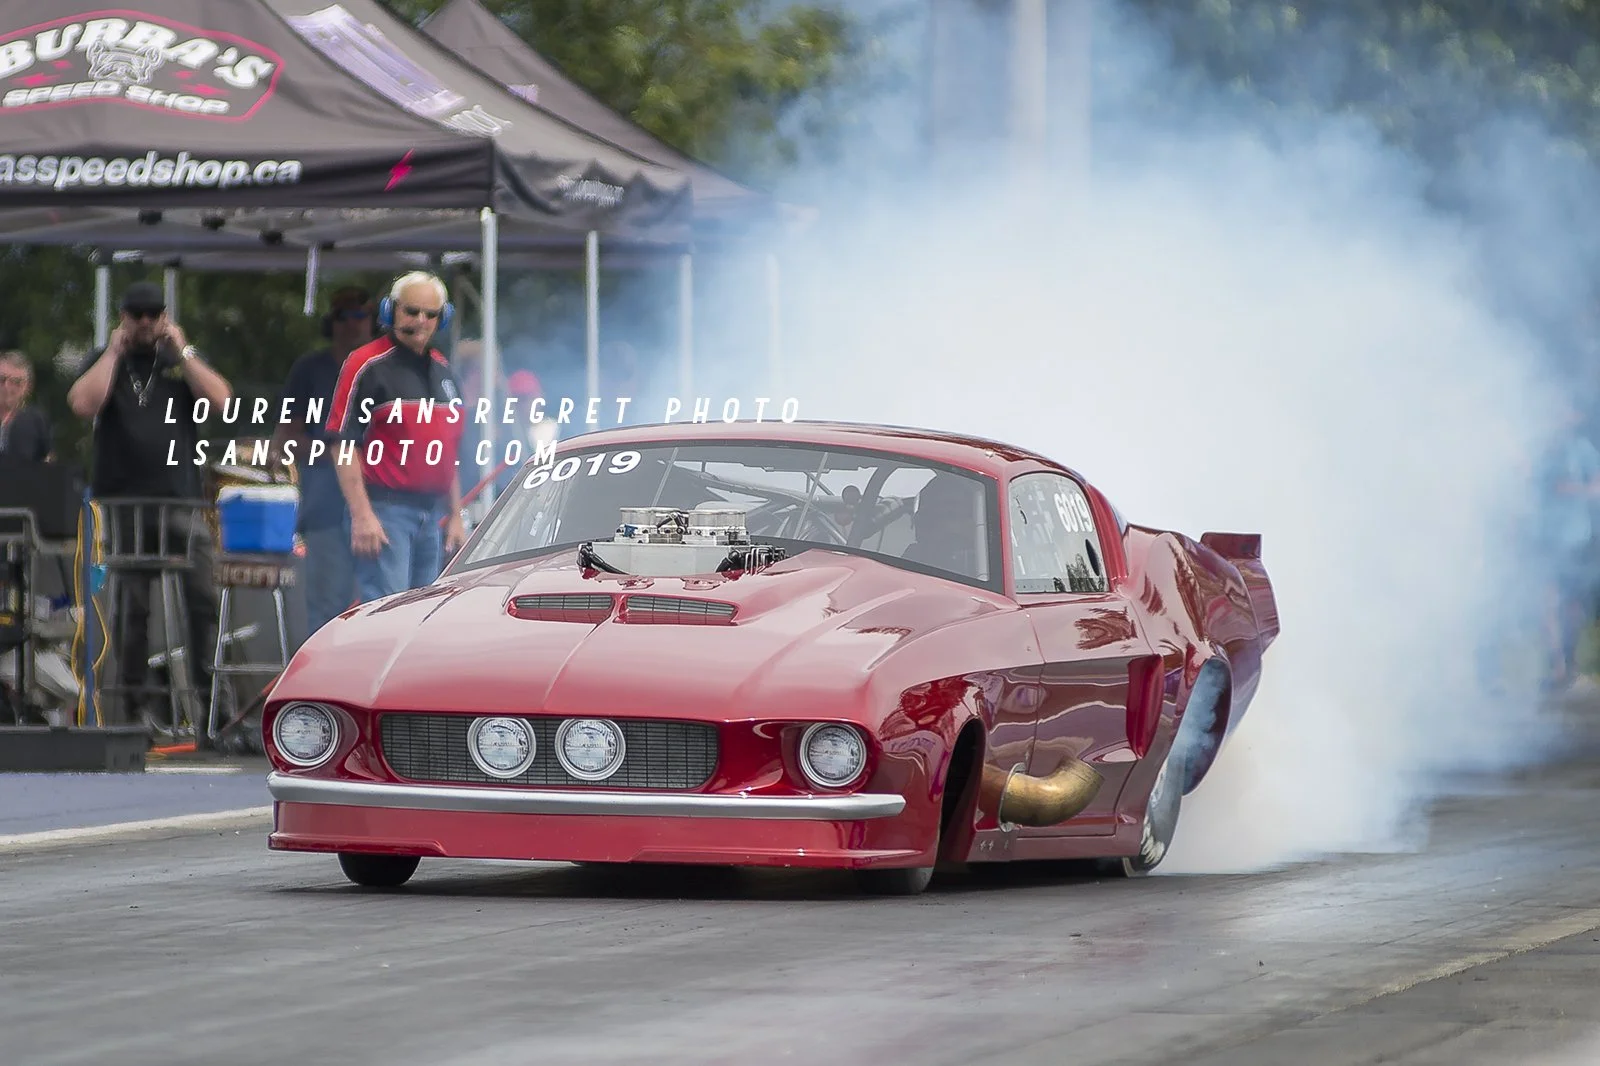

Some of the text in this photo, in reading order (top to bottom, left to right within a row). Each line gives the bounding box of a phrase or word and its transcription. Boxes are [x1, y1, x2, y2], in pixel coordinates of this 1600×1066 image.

[4, 80, 230, 115] SPEED SHOP
[522, 450, 642, 490] 6019
[1053, 492, 1094, 533] 6019
